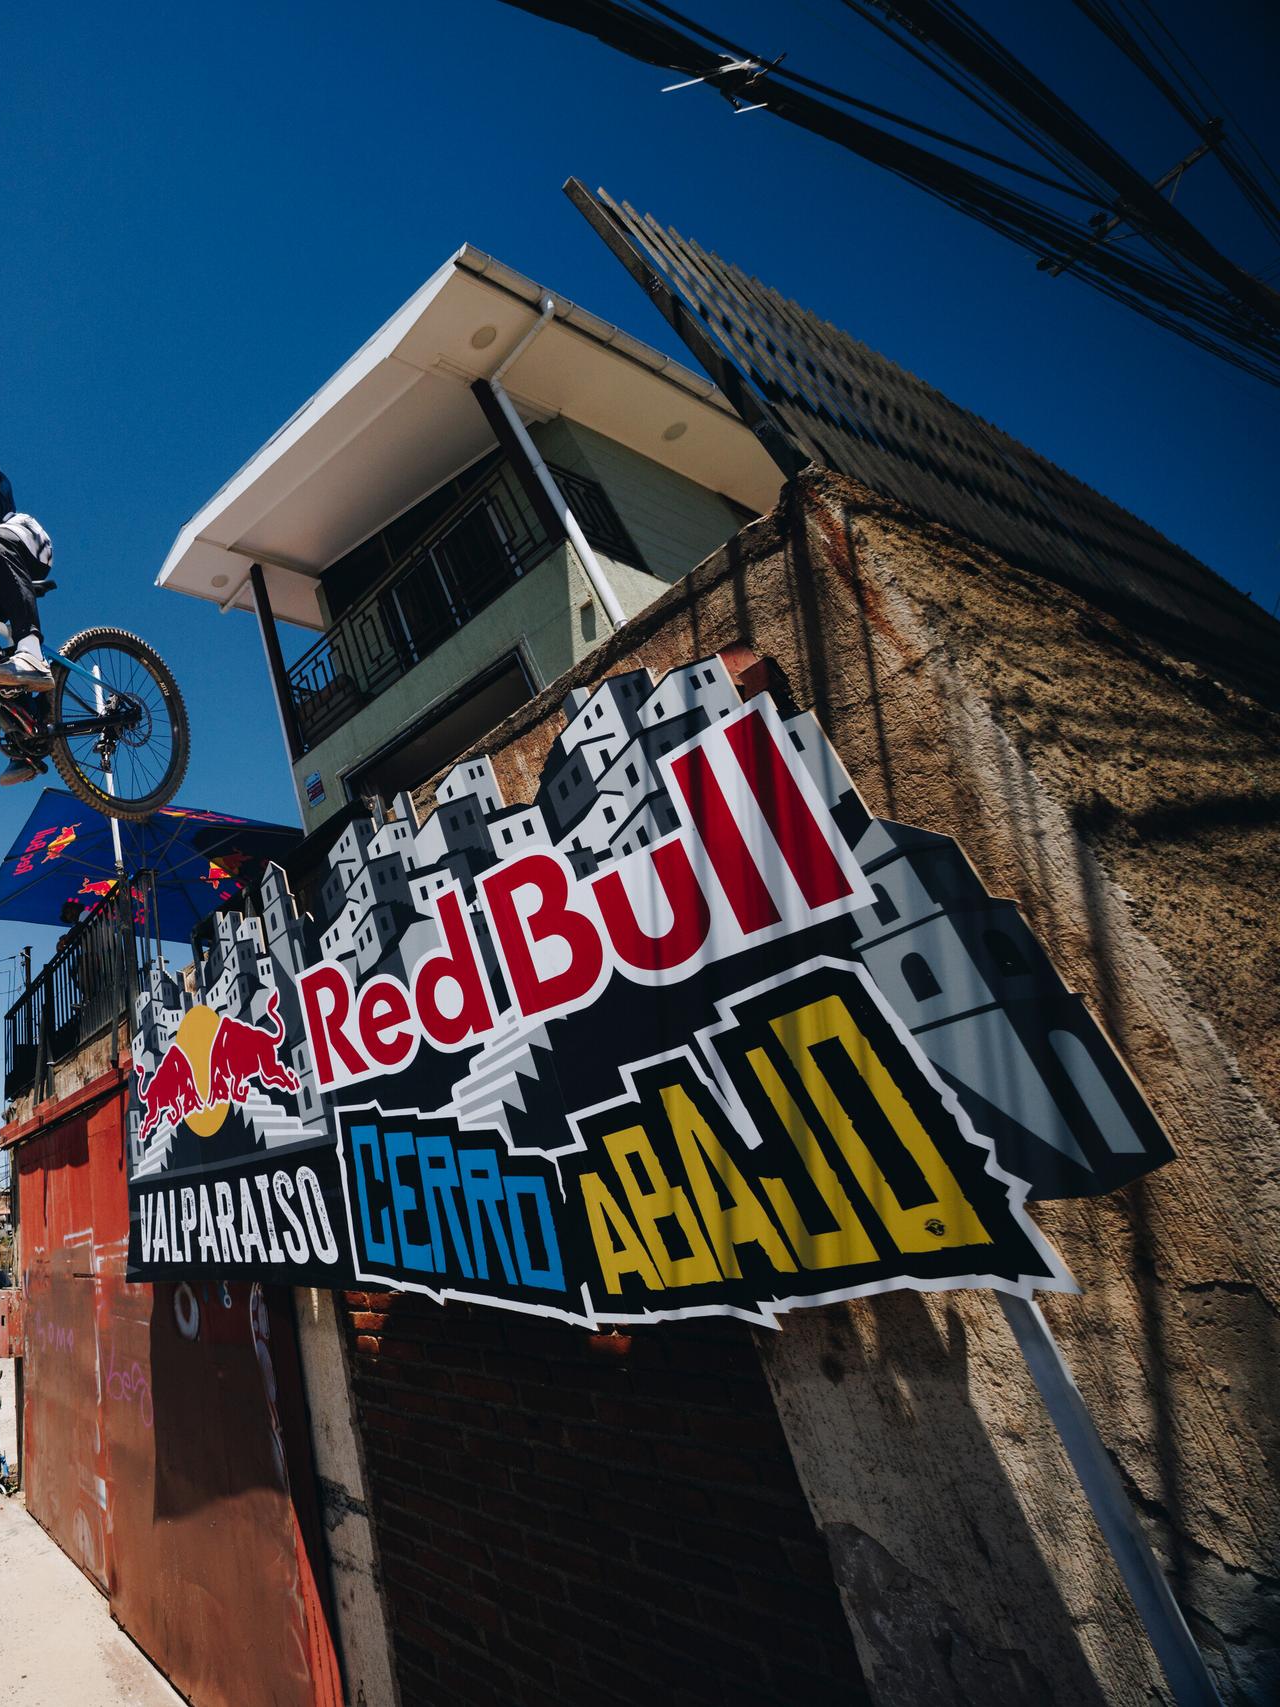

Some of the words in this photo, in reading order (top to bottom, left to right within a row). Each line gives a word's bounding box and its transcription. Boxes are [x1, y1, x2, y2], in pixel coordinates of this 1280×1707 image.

[301, 890, 494, 1085] Red
[482, 709, 854, 1017] Bull
[140, 1166, 338, 1264] VALPARAISO
[350, 1125, 566, 1292] CERRO
[579, 995, 994, 1294] ABAJO
